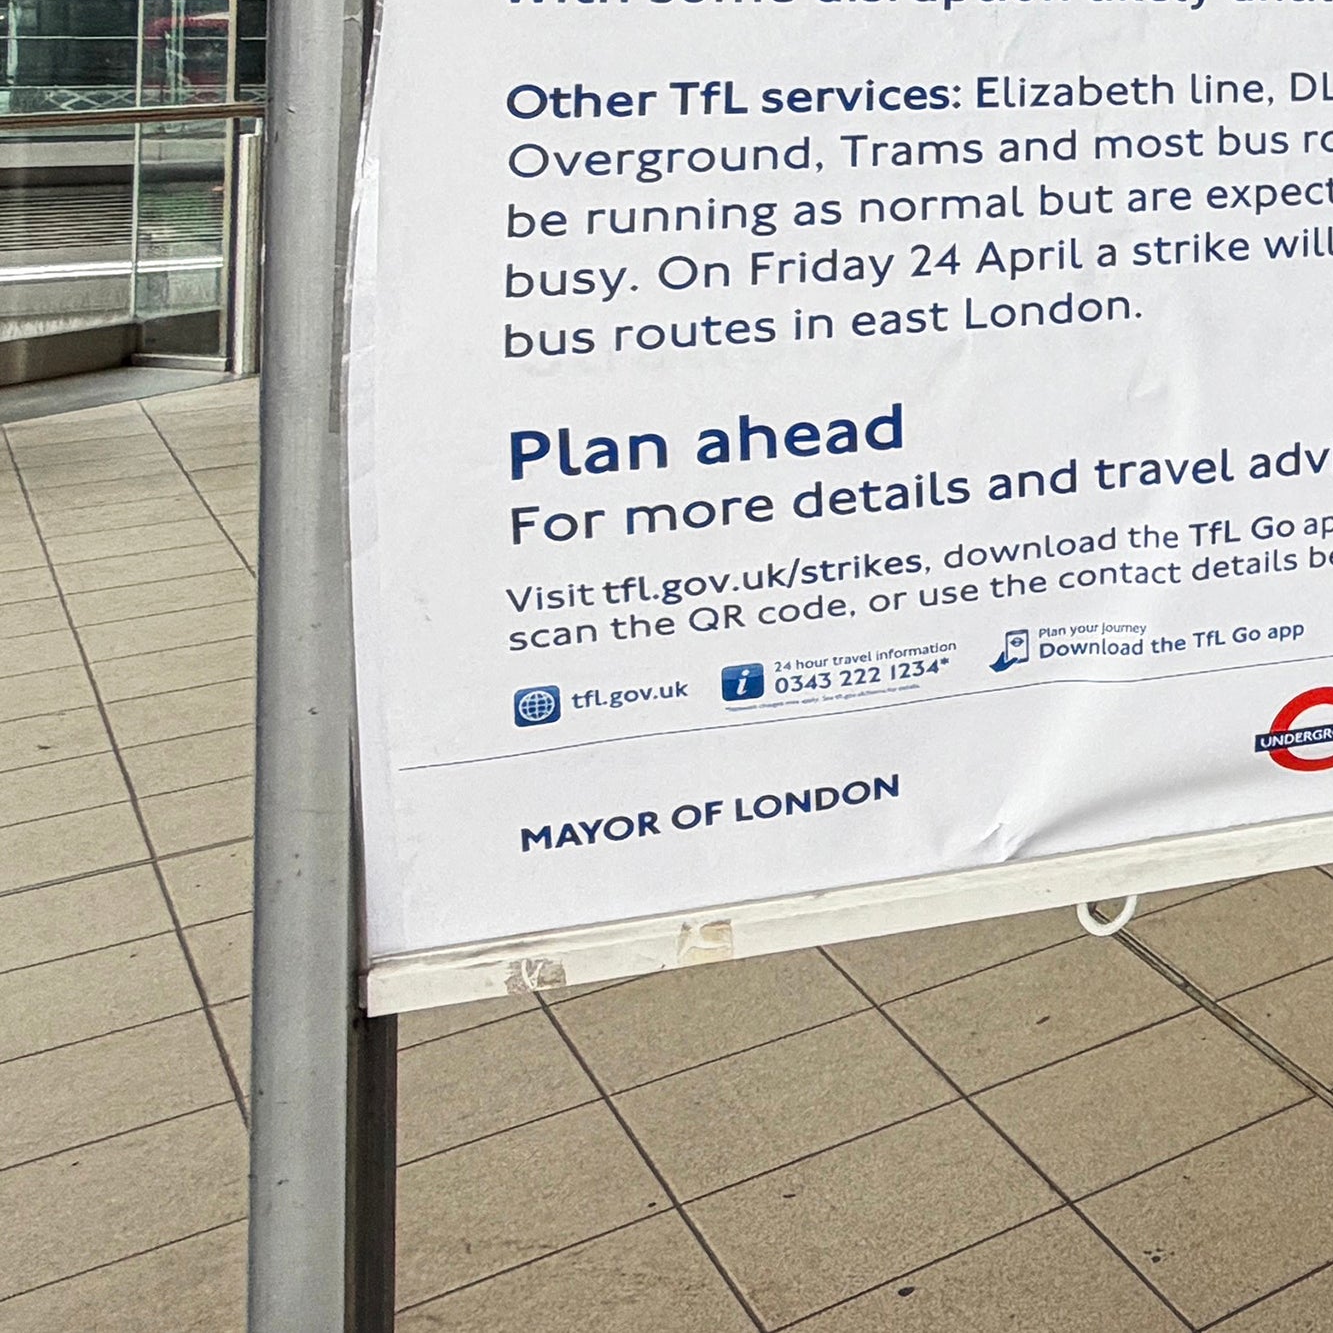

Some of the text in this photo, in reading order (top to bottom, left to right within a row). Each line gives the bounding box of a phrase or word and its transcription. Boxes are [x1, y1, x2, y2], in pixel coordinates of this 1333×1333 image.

[507, 84, 657, 119] Other
[669, 81, 748, 115] TfL
[762, 79, 961, 113] services:
[977, 74, 1173, 108] Elizabeth
[1191, 73, 1273, 106] line,
[511, 403, 902, 480] Plan ahead
[511, 506, 605, 545] For
[626, 495, 773, 535] more
[793, 471, 970, 518] details
[989, 459, 1076, 500] and
[1094, 448, 1234, 490] travel
[506, 584, 594, 612] Visit
[602, 554, 930, 605] tfl.gov.uk/strikes,
[944, 527, 1115, 568] download
[1128, 525, 1178, 548] the
[1188, 520, 1241, 547] TfL
[1251, 516, 1295, 540] Go
[1039, 622, 1147, 638] Plan your journey
[1040, 625, 1304, 659] Download the TfL Go app
[774, 641, 957, 672] 24 hour travel information
[571, 681, 688, 709] tfl.gov.uk
[775, 672, 832, 694] 0343
[840, 666, 881, 687] 222
[521, 774, 899, 852] MAYOR OF LONDON
